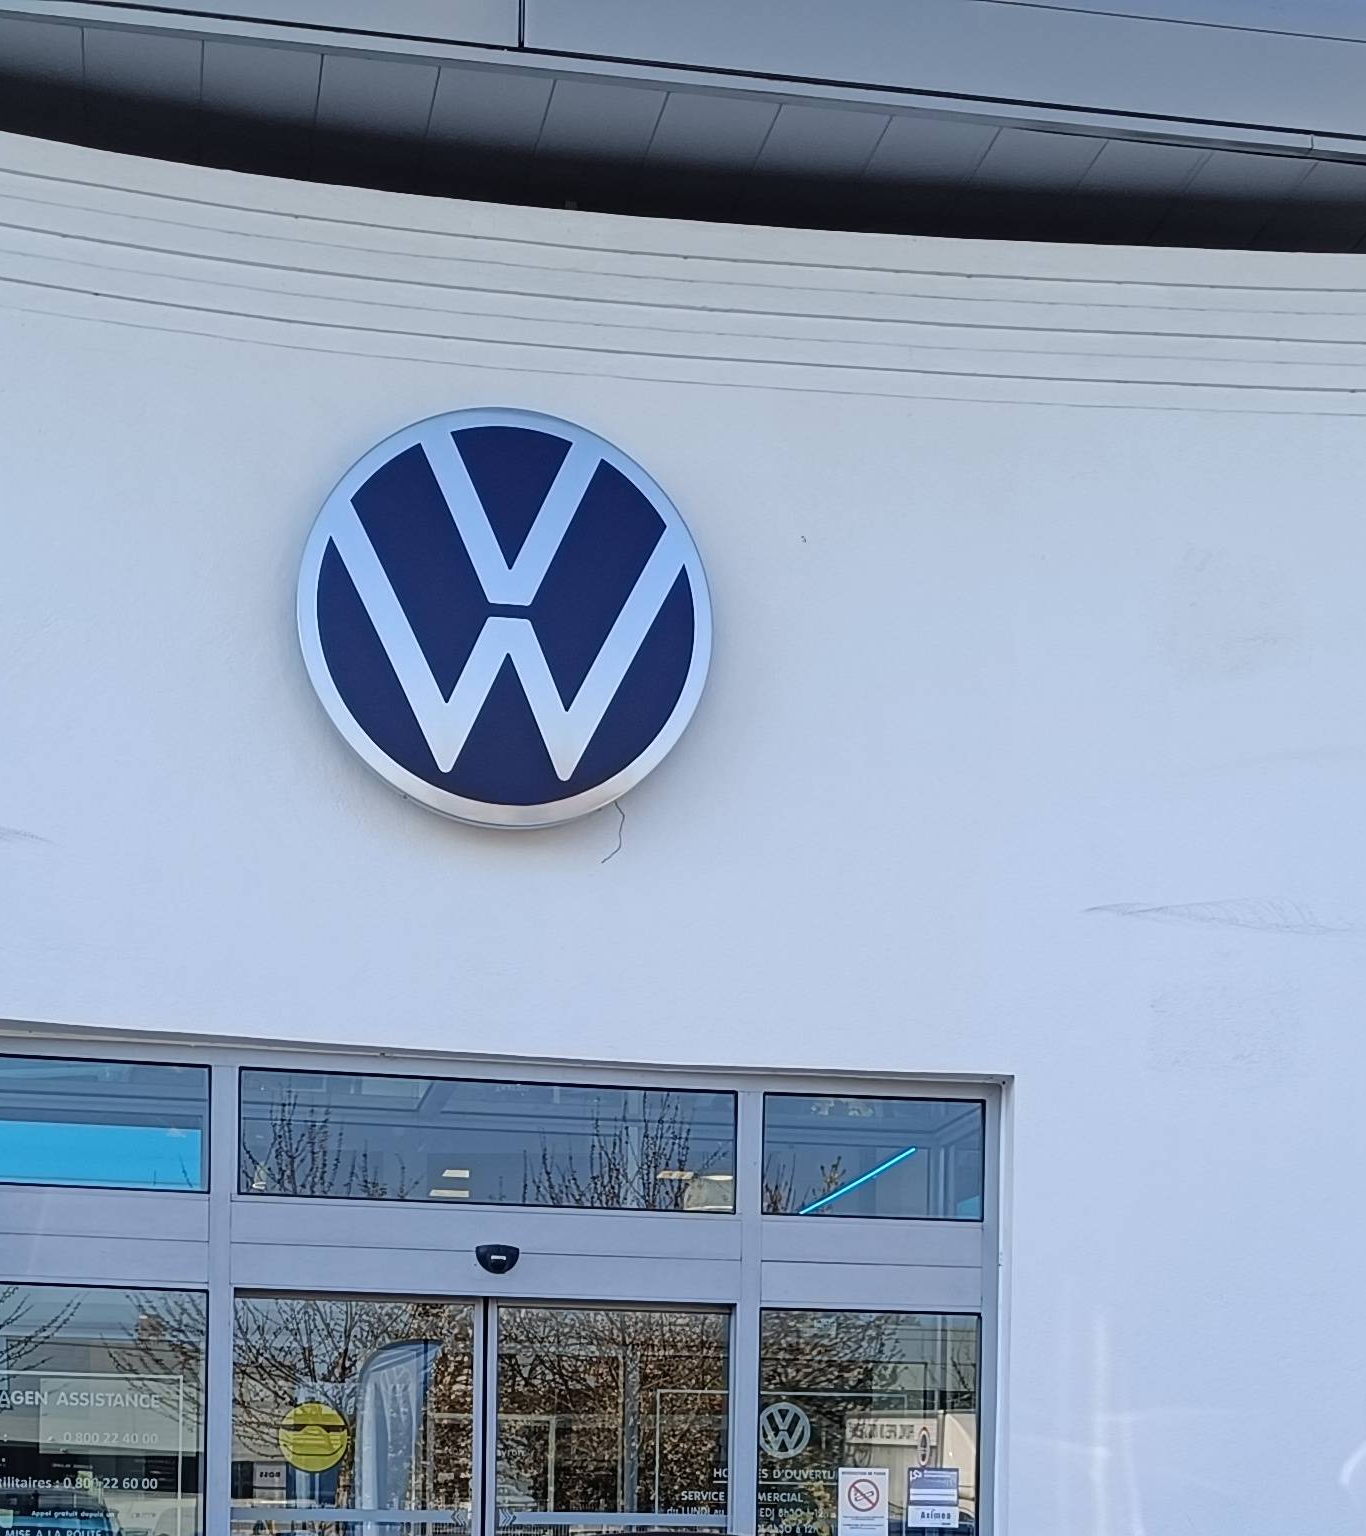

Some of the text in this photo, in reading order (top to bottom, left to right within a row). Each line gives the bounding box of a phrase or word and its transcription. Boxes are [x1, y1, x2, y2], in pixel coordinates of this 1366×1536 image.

[303, 414, 705, 820] VW
[56, 1392, 161, 1409] ASSISTANCE
[64, 1433, 72, 1443] 0
[74, 1433, 99, 1444] 800
[103, 1433, 119, 1444] 22
[122, 1433, 140, 1444] 40
[142, 1433, 159, 1444] 00
[64, 1477, 72, 1489] 0
[74, 1477, 99, 1489] 800
[103, 1477, 118, 1489] 22
[122, 1477, 139, 1489] 60
[141, 1477, 158, 1489] 00
[681, 1491, 725, 1501] SERVICE
[31, 1510, 51, 1518] Appel
